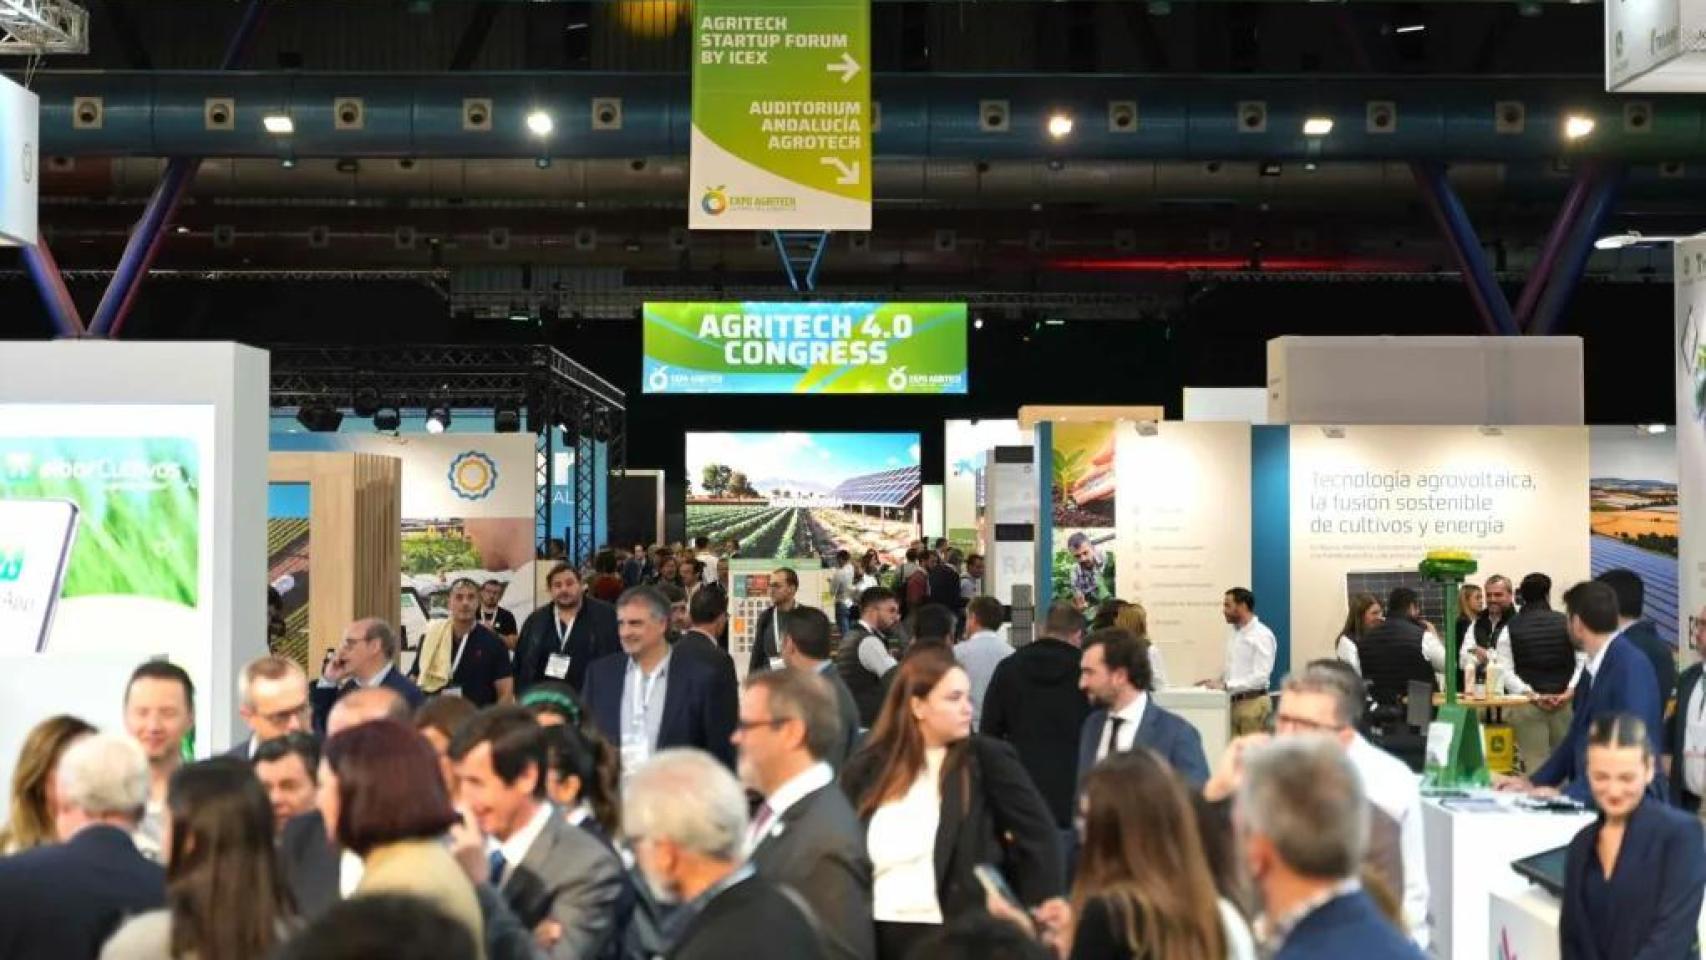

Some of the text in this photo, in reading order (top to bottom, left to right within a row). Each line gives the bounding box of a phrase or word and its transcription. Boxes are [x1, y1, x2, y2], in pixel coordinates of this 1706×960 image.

[701, 16, 788, 31] AGRITECH
[701, 34, 848, 47] STARTUP FORUM
[701, 51, 768, 64] BY ICEX
[749, 101, 860, 115] AUDITORIUM
[761, 116, 860, 132] ANDALUCÍA
[768, 135, 860, 149] AGROTECH
[698, 314, 913, 339] AGRITECH 4.0
[724, 340, 888, 365] CONGRESS
[1311, 470, 1411, 492] Tecnología
[1310, 494, 1493, 511] la fusión sostenible
[1310, 515, 1505, 537] de cultivos y energía
